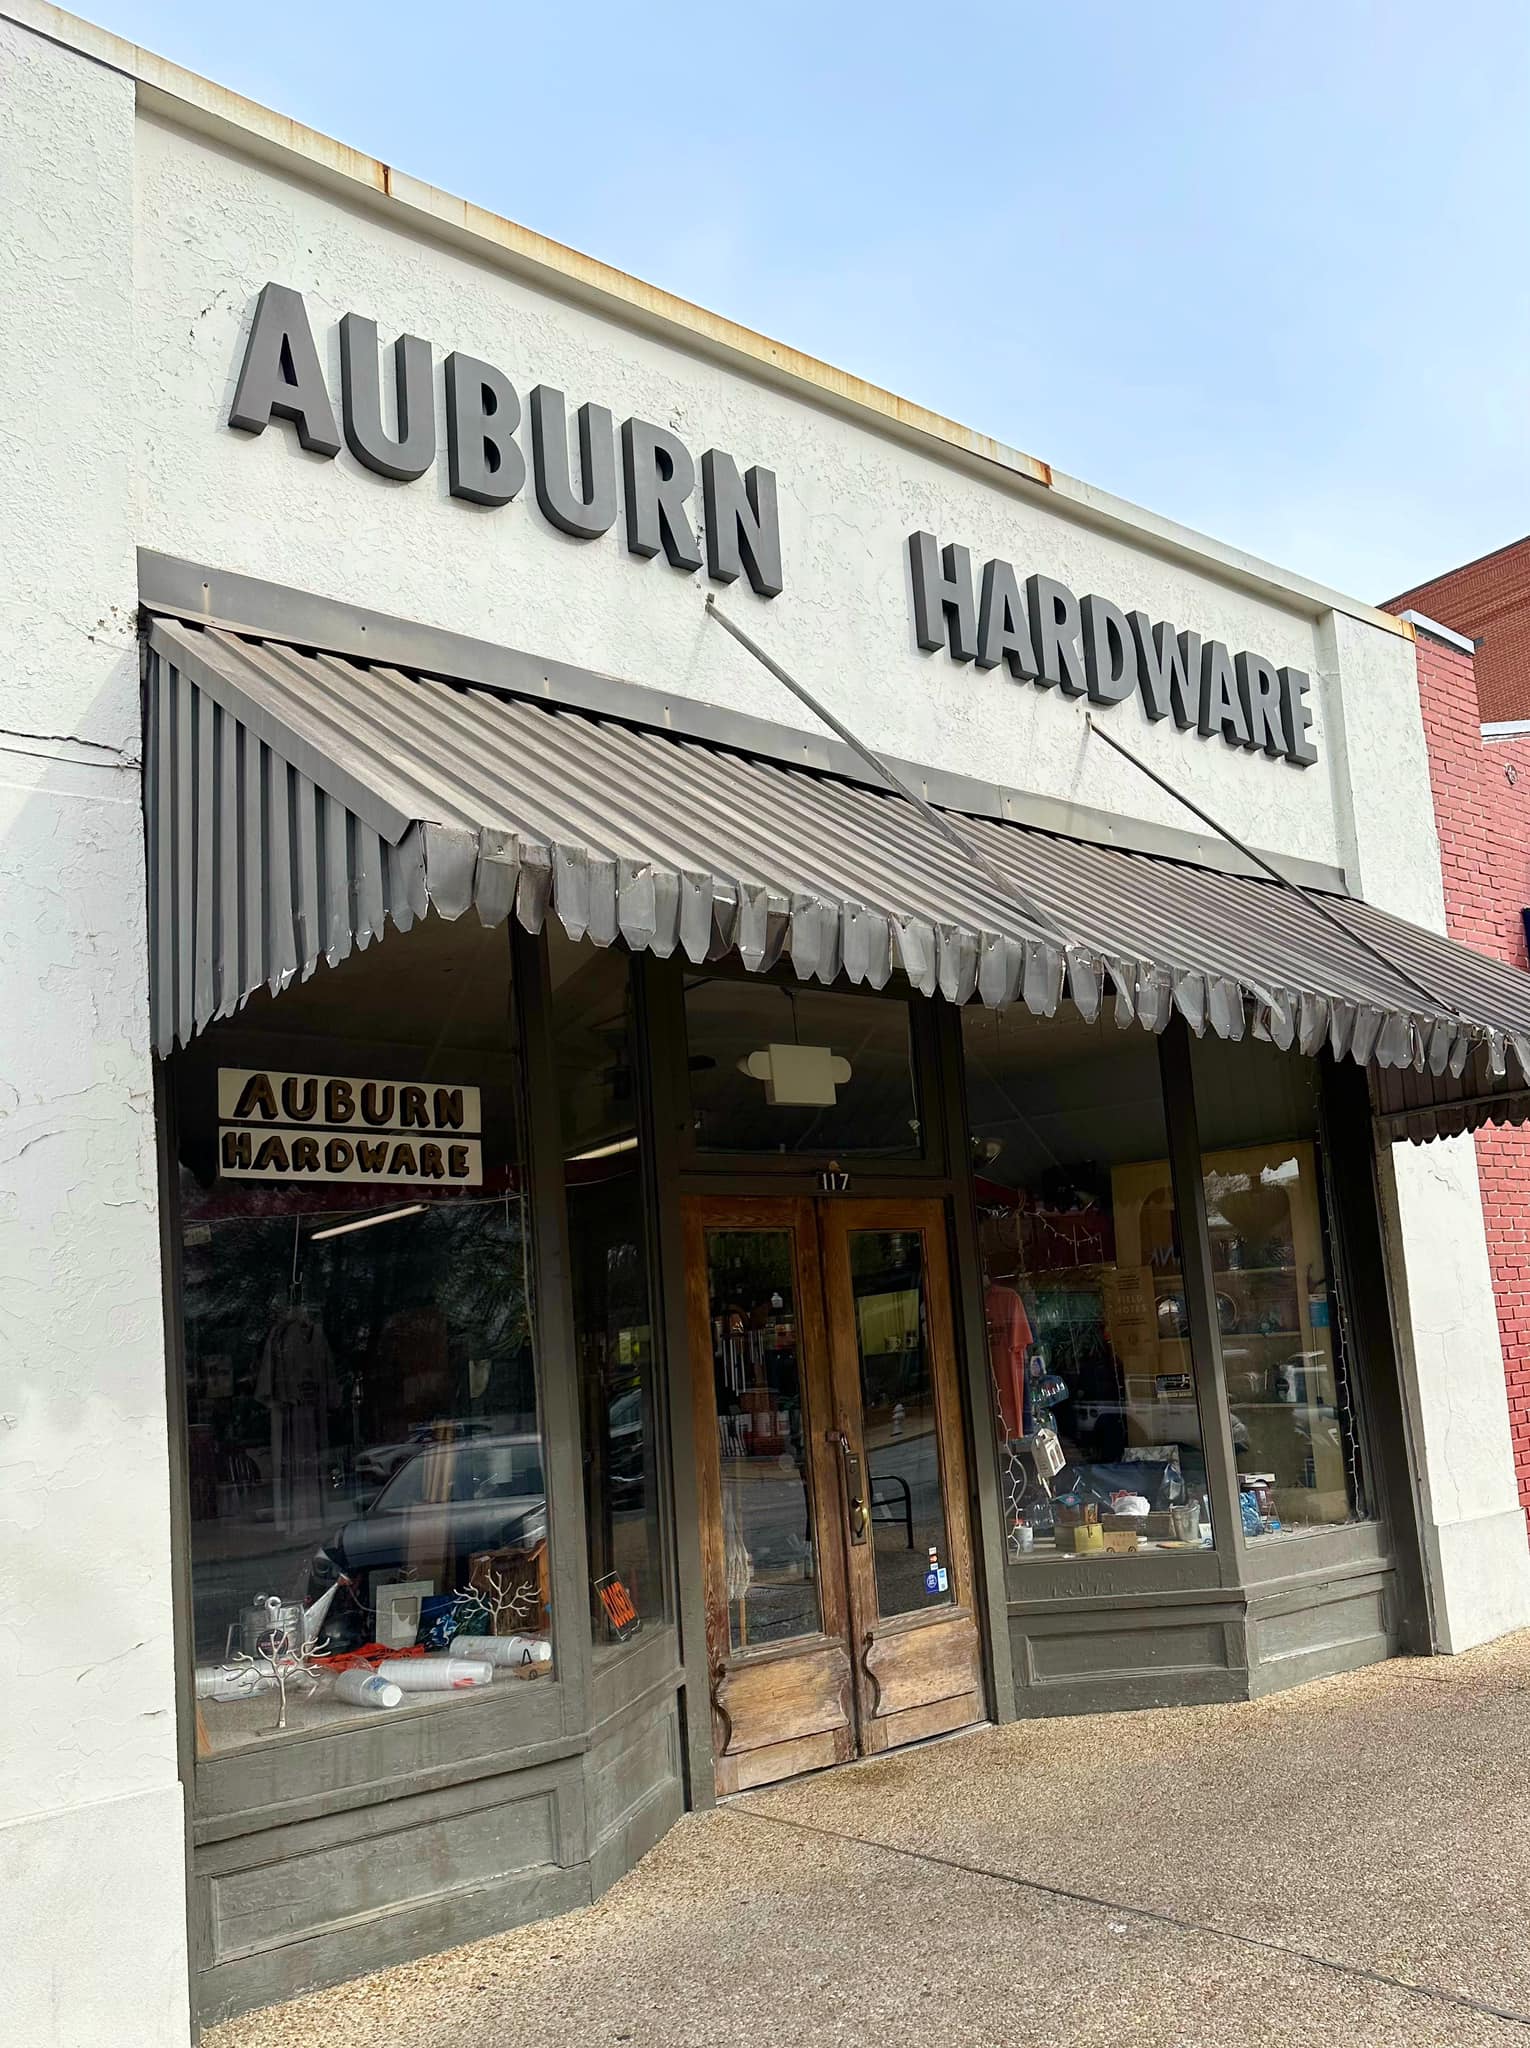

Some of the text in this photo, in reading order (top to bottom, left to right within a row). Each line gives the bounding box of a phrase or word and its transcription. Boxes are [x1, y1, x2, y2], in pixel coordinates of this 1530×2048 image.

[228, 281, 1318, 767] AUBURN HARDWARE
[233, 1073, 464, 1130] AUBURN
[222, 1132, 470, 1179] HARDWARE
[823, 1173, 849, 1190] 117
